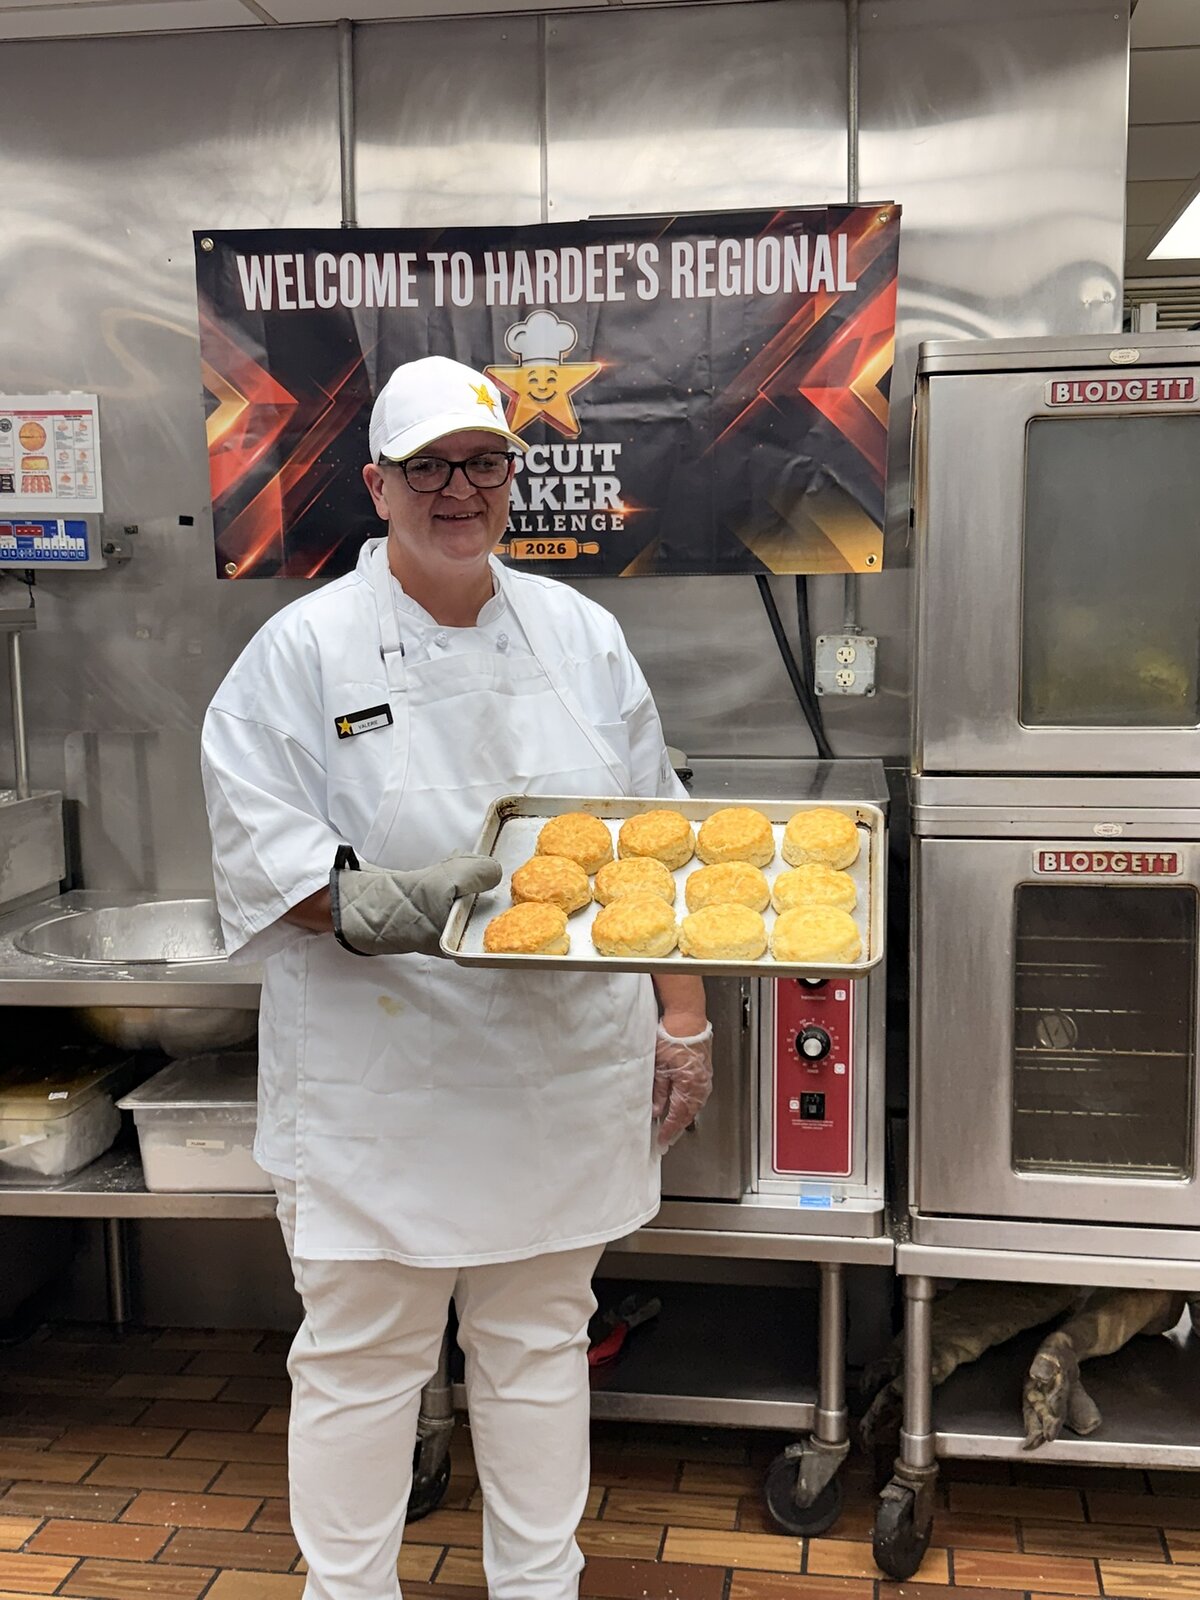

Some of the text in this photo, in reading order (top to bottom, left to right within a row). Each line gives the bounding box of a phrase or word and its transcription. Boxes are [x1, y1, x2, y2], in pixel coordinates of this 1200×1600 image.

[236, 233, 857, 311] WELCOME TO HARDEE'S REGIONAL
[1056, 379, 1189, 402] BLODGETT
[507, 443, 621, 474] SCUIT
[509, 475, 624, 511] AKER
[507, 513, 624, 532] ALLENGE
[525, 543, 567, 555] 2026
[1044, 853, 1173, 872] BLODGETT
